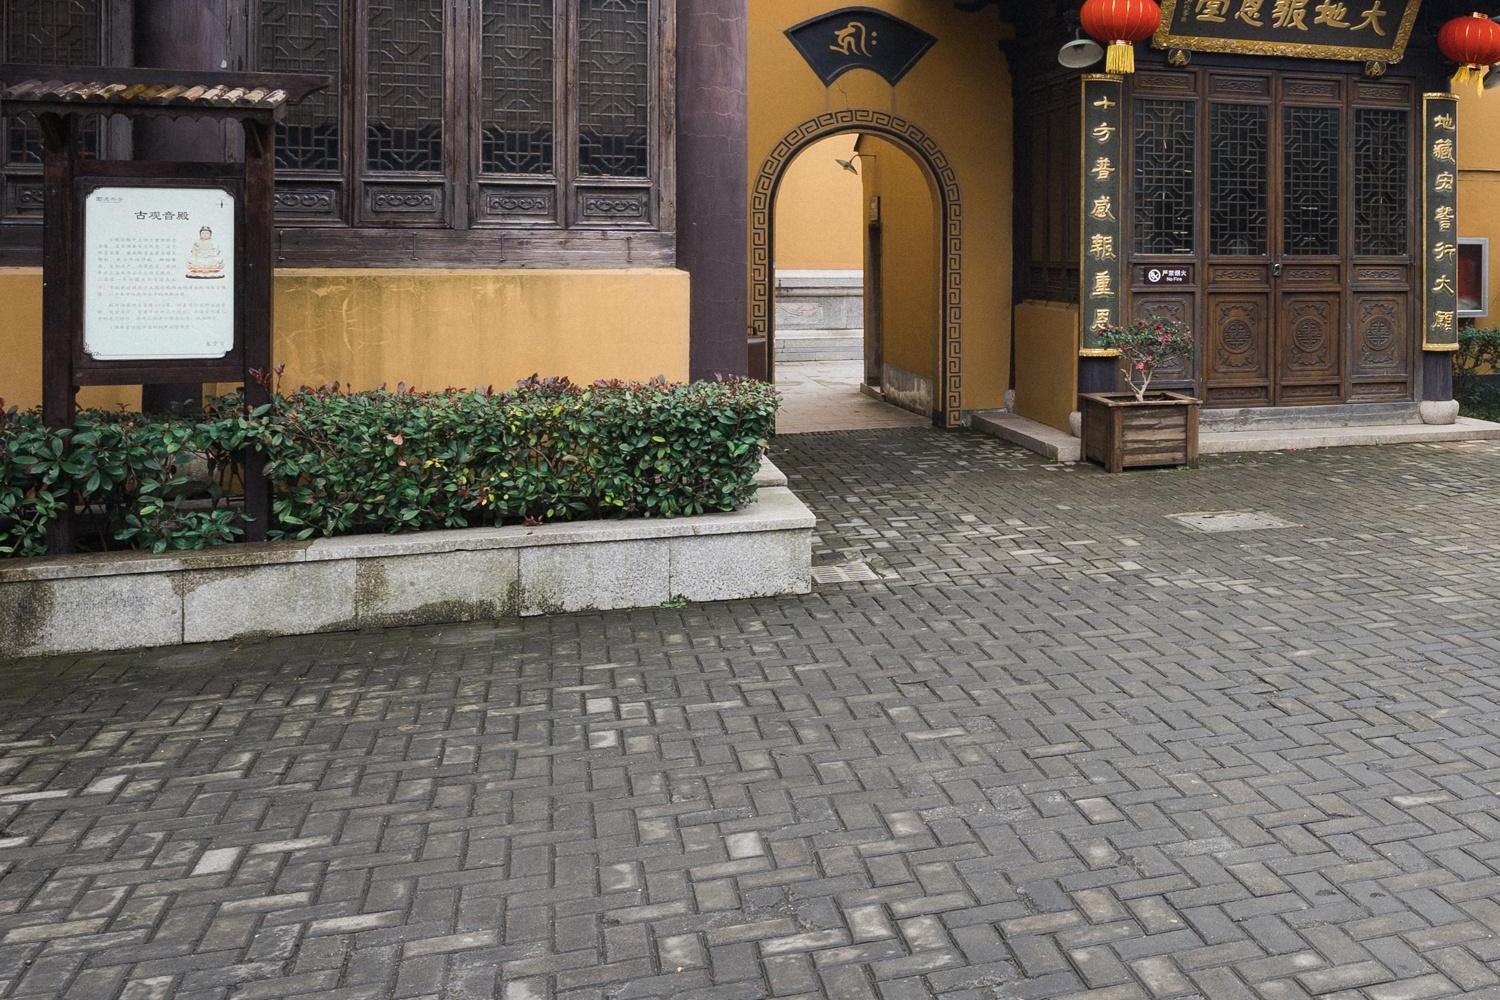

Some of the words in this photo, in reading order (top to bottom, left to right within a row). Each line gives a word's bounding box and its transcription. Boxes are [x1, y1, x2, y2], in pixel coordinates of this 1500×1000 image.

[134, 210, 190, 221] 古观音殿
[1161, 269, 1187, 277] 严禁烟火
